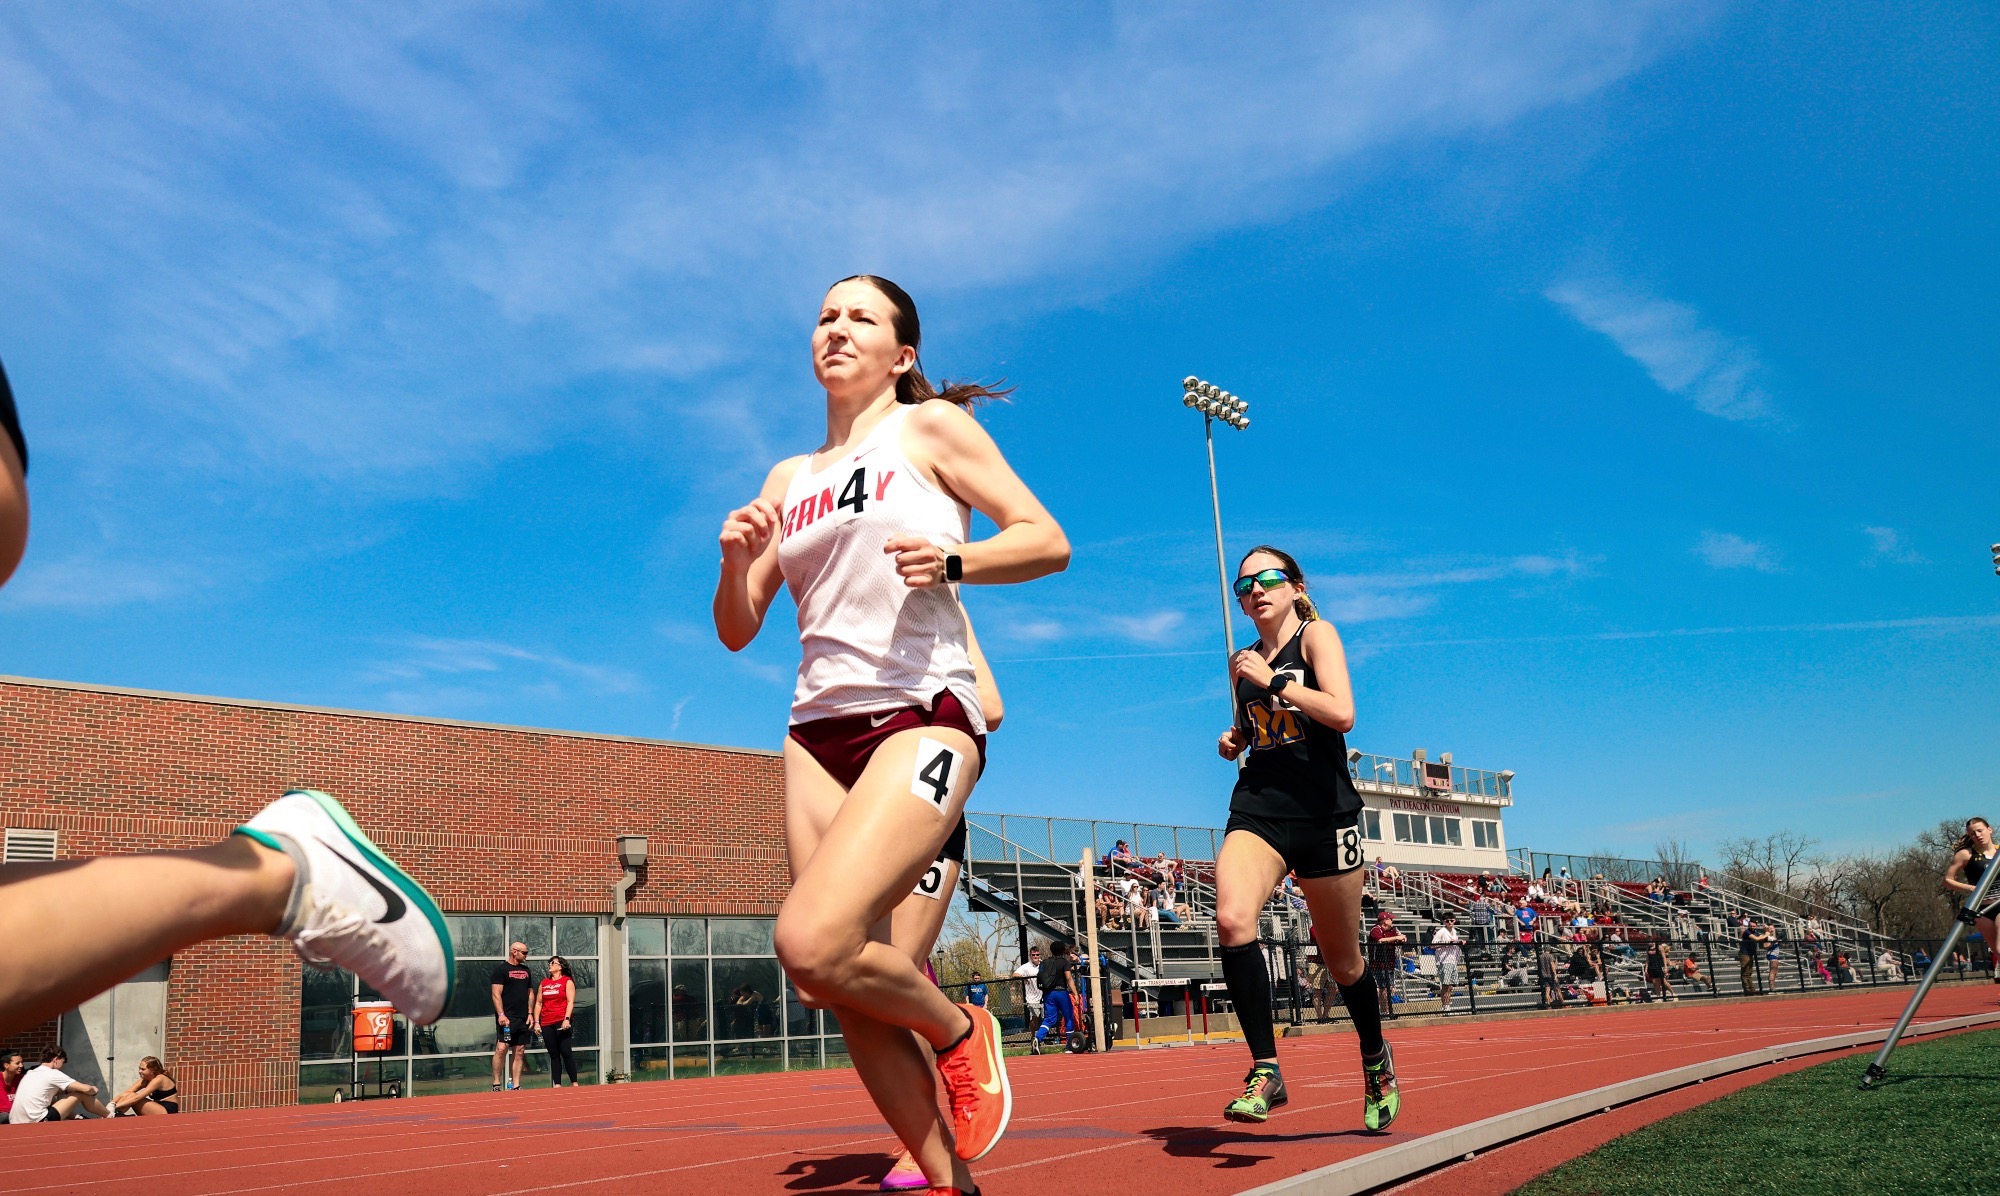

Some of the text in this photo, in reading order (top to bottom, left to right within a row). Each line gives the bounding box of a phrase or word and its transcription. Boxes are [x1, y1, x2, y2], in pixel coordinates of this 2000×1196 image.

[780, 471, 895, 544] RANY
[838, 467, 868, 513] 4
[1246, 699, 1306, 750] M
[919, 748, 953, 805] 4
[1390, 799, 1460, 814] PAT DEACON STADIUM
[1343, 829, 1357, 866] 8
[919, 856, 944, 894] 5
[375, 1013, 387, 1028] G
